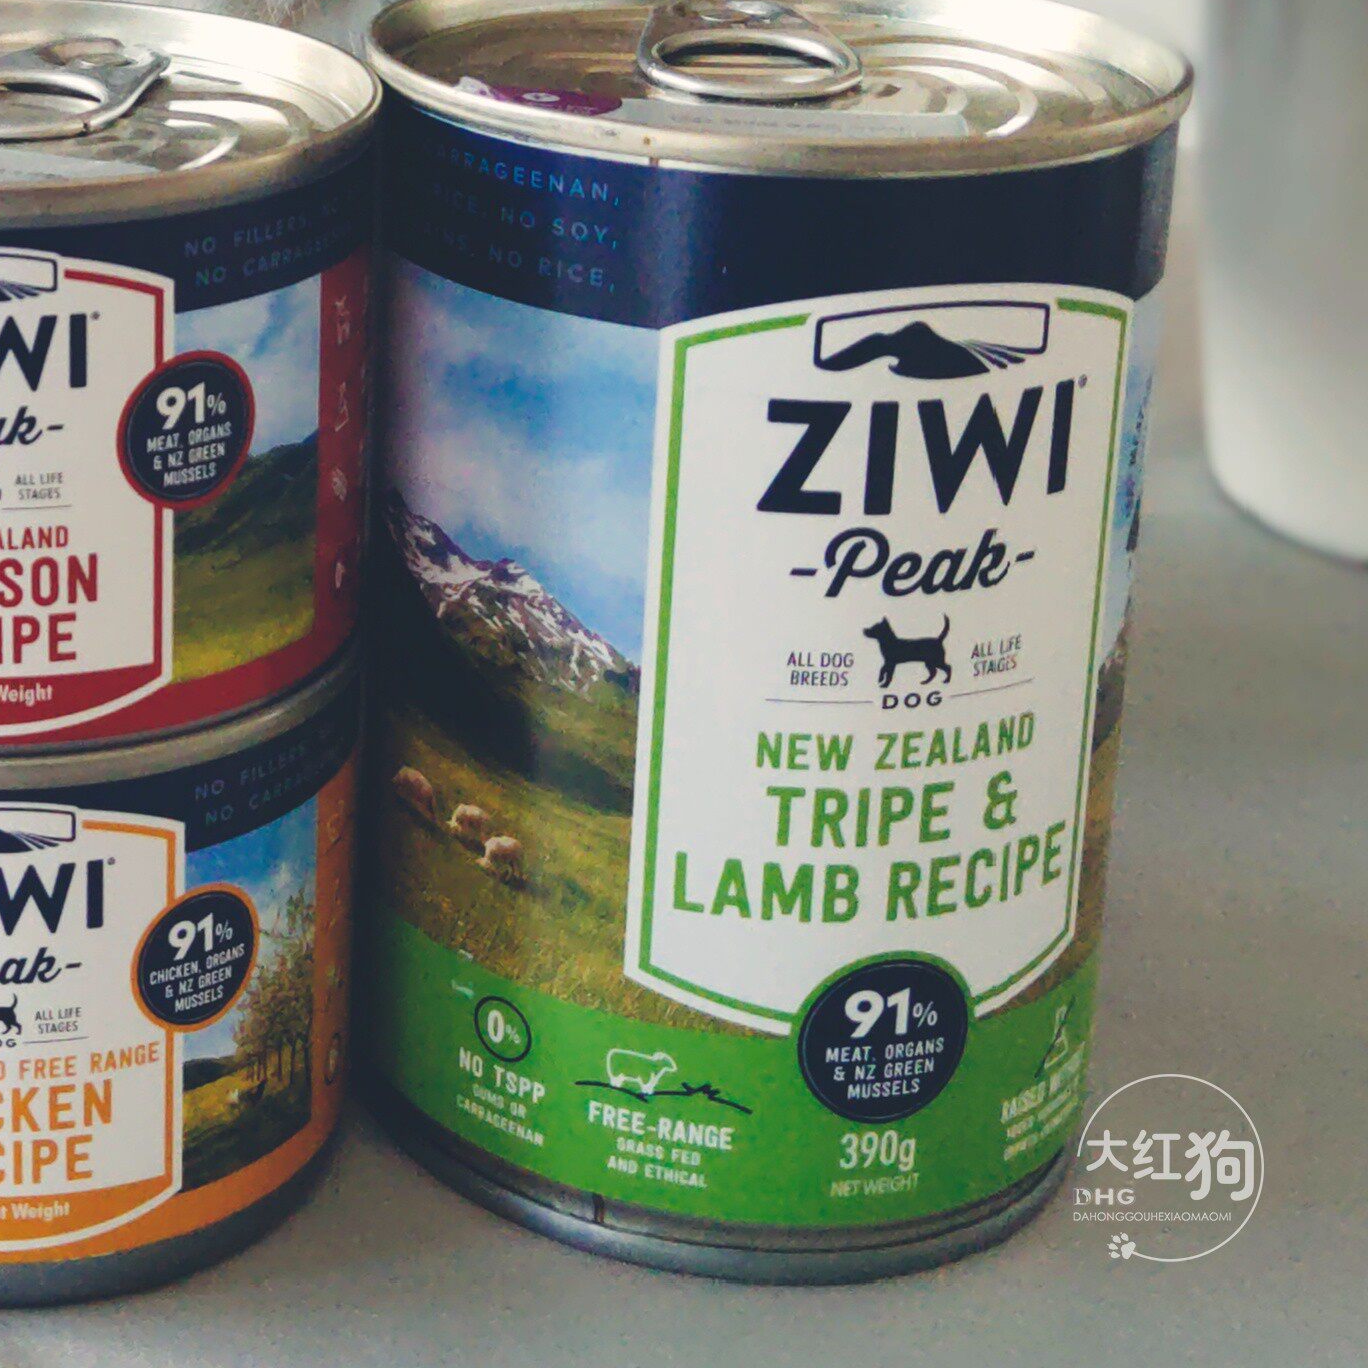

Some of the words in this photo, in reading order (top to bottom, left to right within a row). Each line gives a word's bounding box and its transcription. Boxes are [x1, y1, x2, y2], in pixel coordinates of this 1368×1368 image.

[435, 144, 619, 207] ARRAGEENAN,
[500, 205, 535, 229] NO
[550, 217, 618, 250] SOY,
[184, 236, 217, 258] NO
[195, 265, 226, 286] NO
[488, 243, 522, 269] NO
[538, 256, 615, 294] RICE,
[156, 382, 228, 430] 91%
[188, 421, 232, 445] ORGANS
[756, 377, 1075, 516] ZIWI
[153, 454, 163, 471] &
[168, 449, 183, 468] NZ
[188, 442, 225, 464] GREEN
[15, 473, 36, 486] ALL
[39, 472, 63, 485] LIFE
[163, 465, 217, 488] MUSSELS
[18, 487, 61, 500] STAGES
[786, 651, 815, 668] ALL
[820, 651, 854, 669] DOG
[971, 640, 996, 659] ALL
[1000, 634, 1022, 653] LIFE
[790, 670, 849, 687] BREEDS
[973, 654, 1018, 677] STAGES
[881, 691, 944, 710] DOG
[756, 731, 854, 771] NEW
[874, 711, 1035, 771] ZEALAND
[766, 780, 955, 849] TRIPE
[983, 769, 1018, 831] &
[673, 851, 859, 924] LAMB
[886, 819, 1067, 922] RECIPE
[168, 913, 234, 961] 91%
[149, 961, 202, 985] CHICKEN,
[206, 943, 245, 969] ORGANS
[165, 983, 174, 998] &
[179, 978, 193, 995] NZ
[198, 965, 232, 988] GREEN
[175, 985, 224, 1012] MUSSELS
[35, 1008, 54, 1020] ALL
[57, 1007, 82, 1019] LIFE
[38, 1020, 79, 1033] STAGES
[844, 987, 938, 1039] 91%
[19, 1055, 77, 1080] FREE
[90, 1041, 160, 1073] RANGE
[885, 1037, 945, 1059] ORGANS
[459, 1047, 483, 1078] NO
[493, 1064, 546, 1104] TSPP
[833, 1066, 845, 1082] &
[855, 1064, 875, 1081] NZ
[884, 1058, 934, 1078] GREEN
[847, 1079, 920, 1100] MUSSELS
[588, 1100, 735, 1151] FREE-RANGE
[617, 1136, 664, 1160] GRASS
[671, 1148, 701, 1167] FED
[839, 1129, 916, 1172] 390g
[607, 1155, 638, 1175] AND
[644, 1163, 707, 1189] ETHICAL
[830, 1180, 860, 1197] NET
[863, 1173, 919, 1194] WEIGHT
[10, 1200, 70, 1222] Weight
